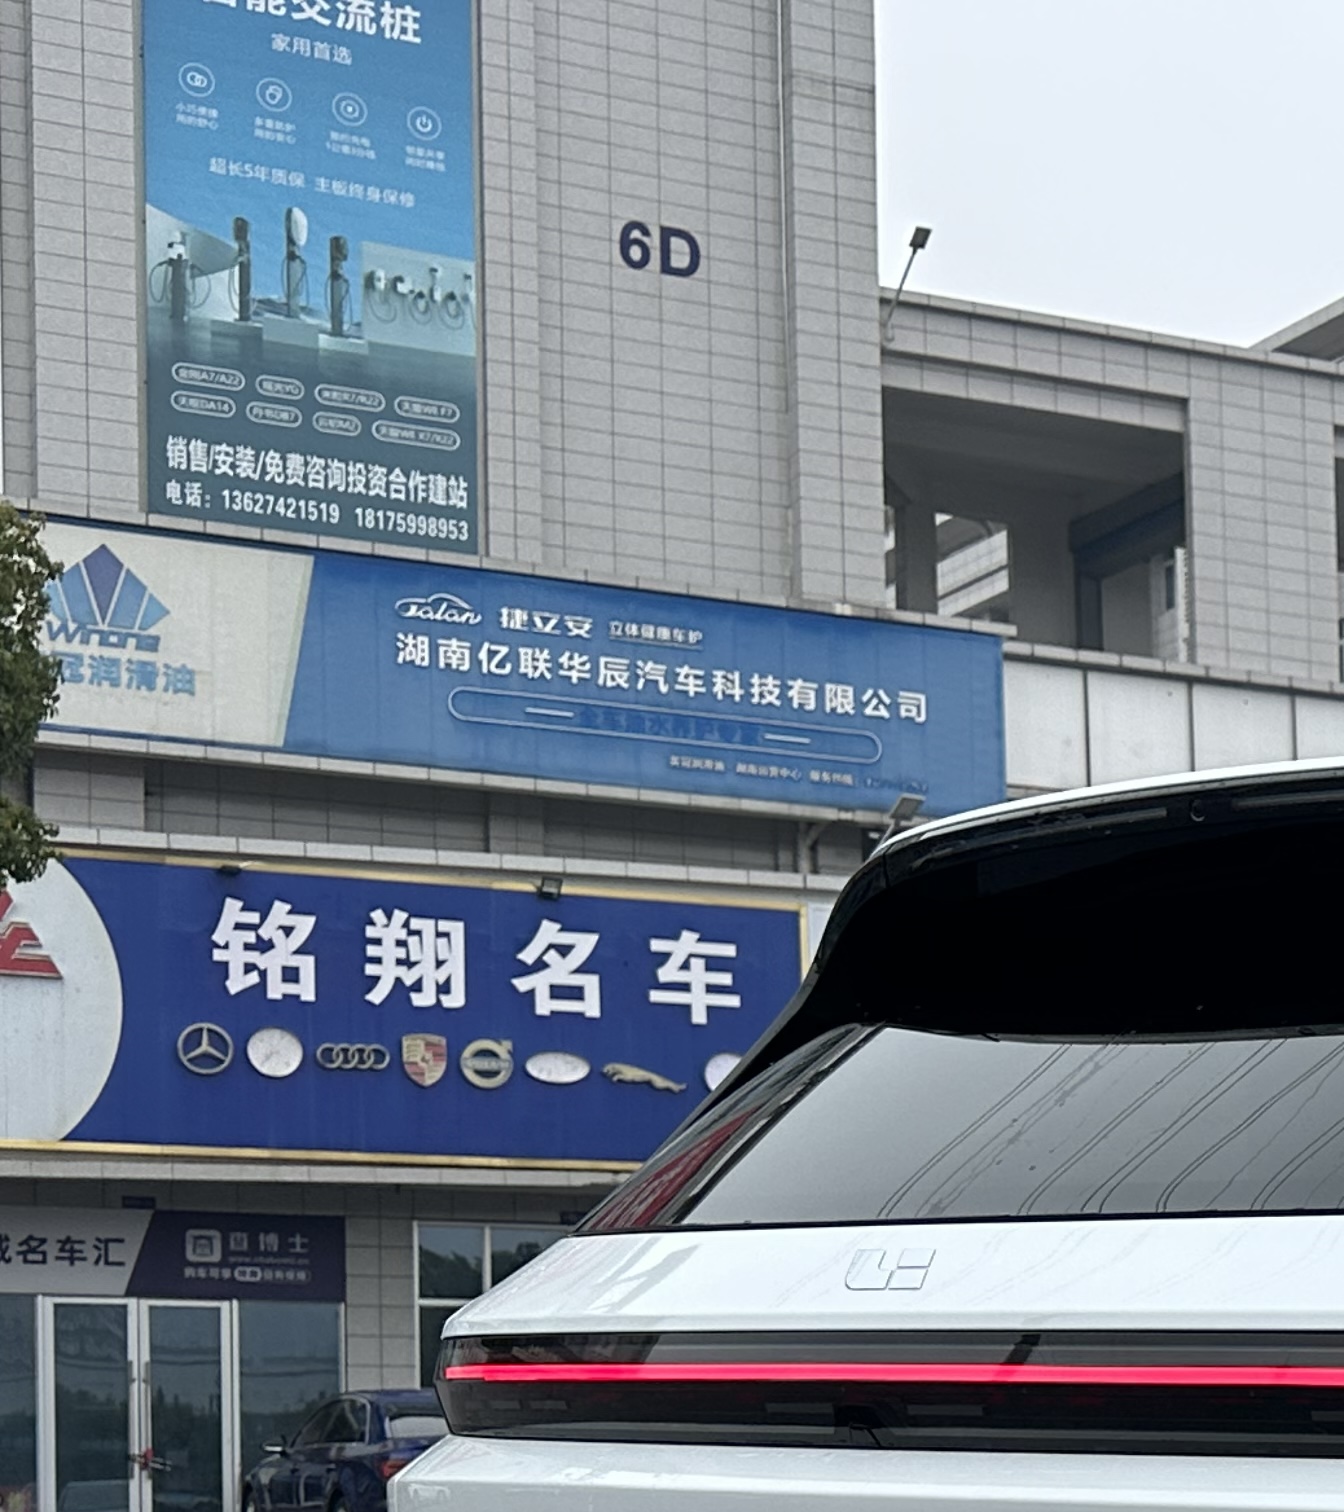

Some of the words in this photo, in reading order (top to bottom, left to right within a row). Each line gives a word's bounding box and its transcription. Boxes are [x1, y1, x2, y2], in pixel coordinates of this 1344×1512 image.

[206, 0, 421, 43] 交流桩
[271, 33, 352, 65] 家用首选
[209, 156, 305, 188] 超长5年质保
[314, 176, 415, 208] 主板终身保修
[619, 221, 701, 279] 6D
[166, 434, 469, 510] 销售/安装/免费咨询投资合作建站
[222, 489, 340, 524] 13627421519
[354, 508, 469, 541] 18175998953
[499, 606, 593, 639] 捷立安
[396, 632, 929, 724] 湖南亿联华辰汽车科技有限公司
[212, 896, 741, 1025] 铭翔名车
